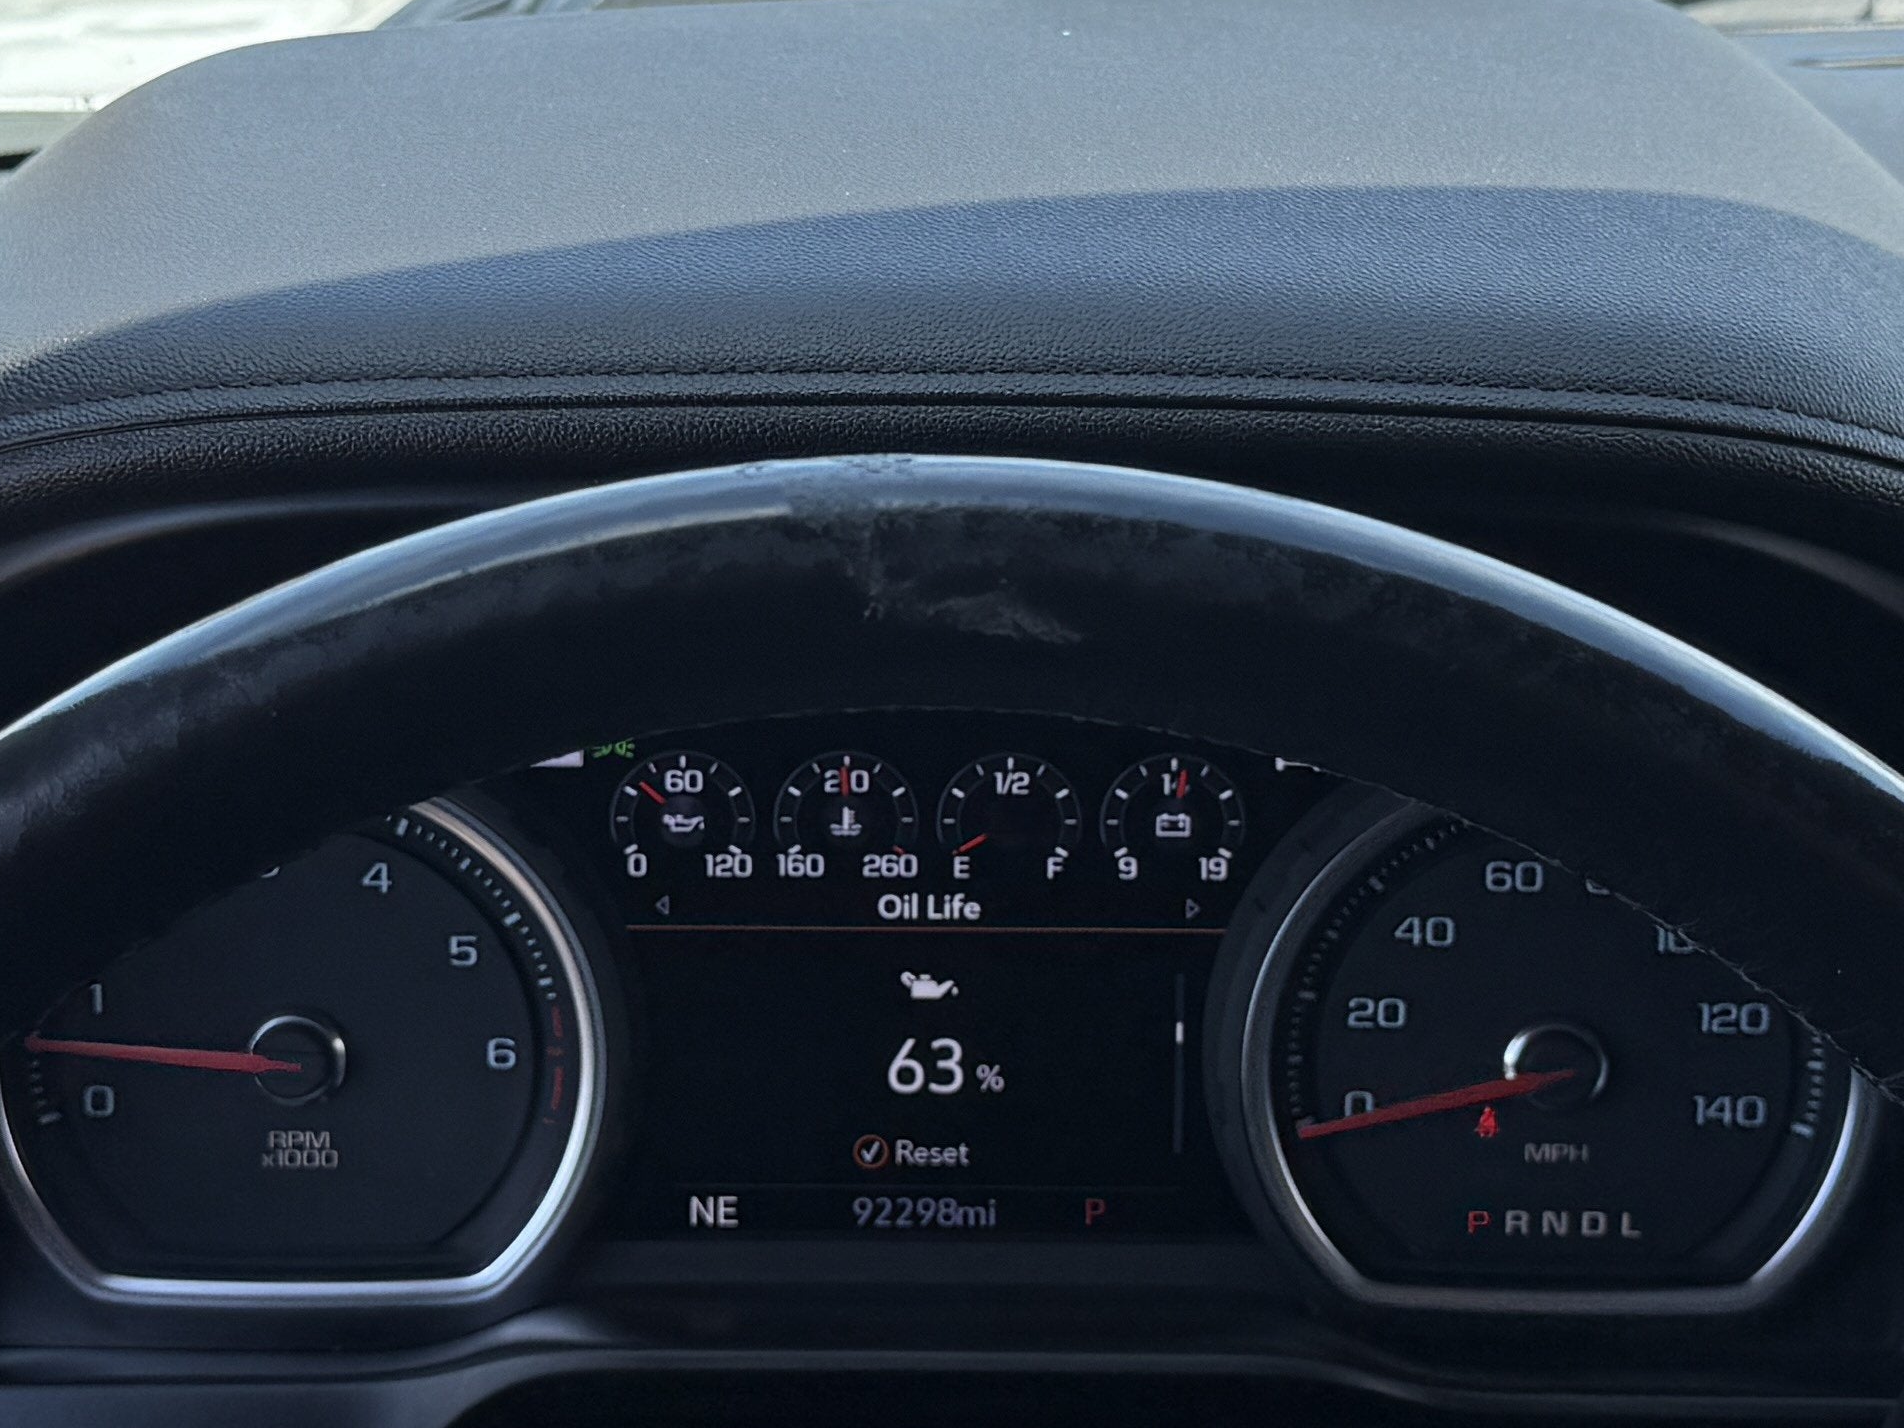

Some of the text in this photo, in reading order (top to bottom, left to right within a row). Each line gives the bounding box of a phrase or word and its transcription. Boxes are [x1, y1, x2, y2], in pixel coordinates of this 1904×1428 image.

[665, 770, 703, 793] 60
[995, 771, 1031, 795] 1/2
[362, 862, 392, 894] 4
[627, 854, 752, 878] 0 120
[778, 854, 918, 878] 160 260
[954, 856, 1063, 880] E F
[1117, 856, 1227, 881] 9 19
[1485, 861, 1544, 893] 60
[878, 893, 981, 920] Oil Life
[1394, 916, 1456, 947] 40
[1655, 924, 1696, 954] 10
[448, 935, 478, 967] 5
[89, 983, 104, 1014] 1
[1347, 997, 1407, 1029] 20
[1699, 1002, 1770, 1035] 120
[486, 1038, 516, 1071] 6
[888, 1037, 1005, 1094] 63 %
[82, 1086, 115, 1118] 0
[1343, 1091, 1375, 1118] 0
[1693, 1095, 1767, 1128] 140
[267, 1131, 330, 1149] RPM
[895, 1139, 970, 1166] Reset
[1524, 1143, 1589, 1164] MPH
[262, 1149, 338, 1169] x1000
[689, 1195, 739, 1228] NE
[852, 1196, 997, 1228] 92298mi
[1084, 1198, 1106, 1226] P
[1467, 1211, 1642, 1238] P R N D L
